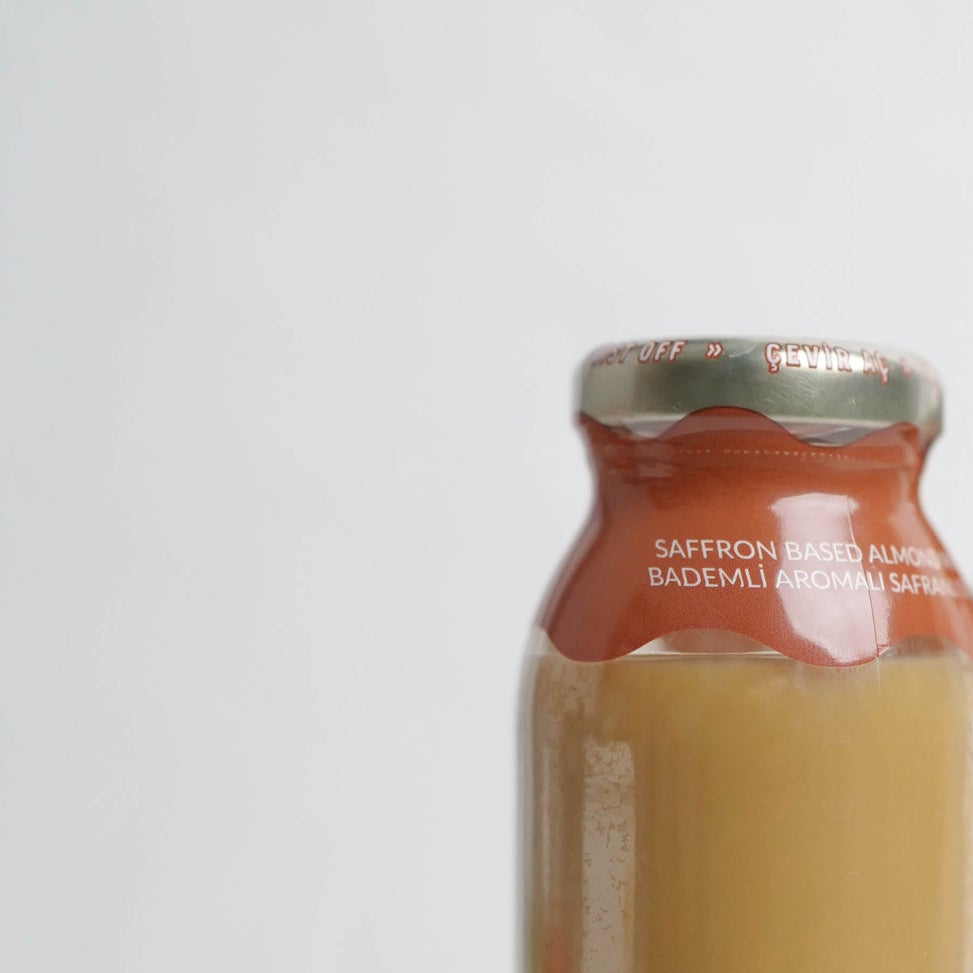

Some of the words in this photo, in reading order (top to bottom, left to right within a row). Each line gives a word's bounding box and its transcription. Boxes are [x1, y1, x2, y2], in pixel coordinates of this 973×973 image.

[638, 339, 688, 363] OFF
[655, 539, 777, 561] SAFFRON
[785, 541, 863, 563] BASED
[648, 564, 767, 588] BADEMLİ
[775, 568, 885, 592] AROMALI
